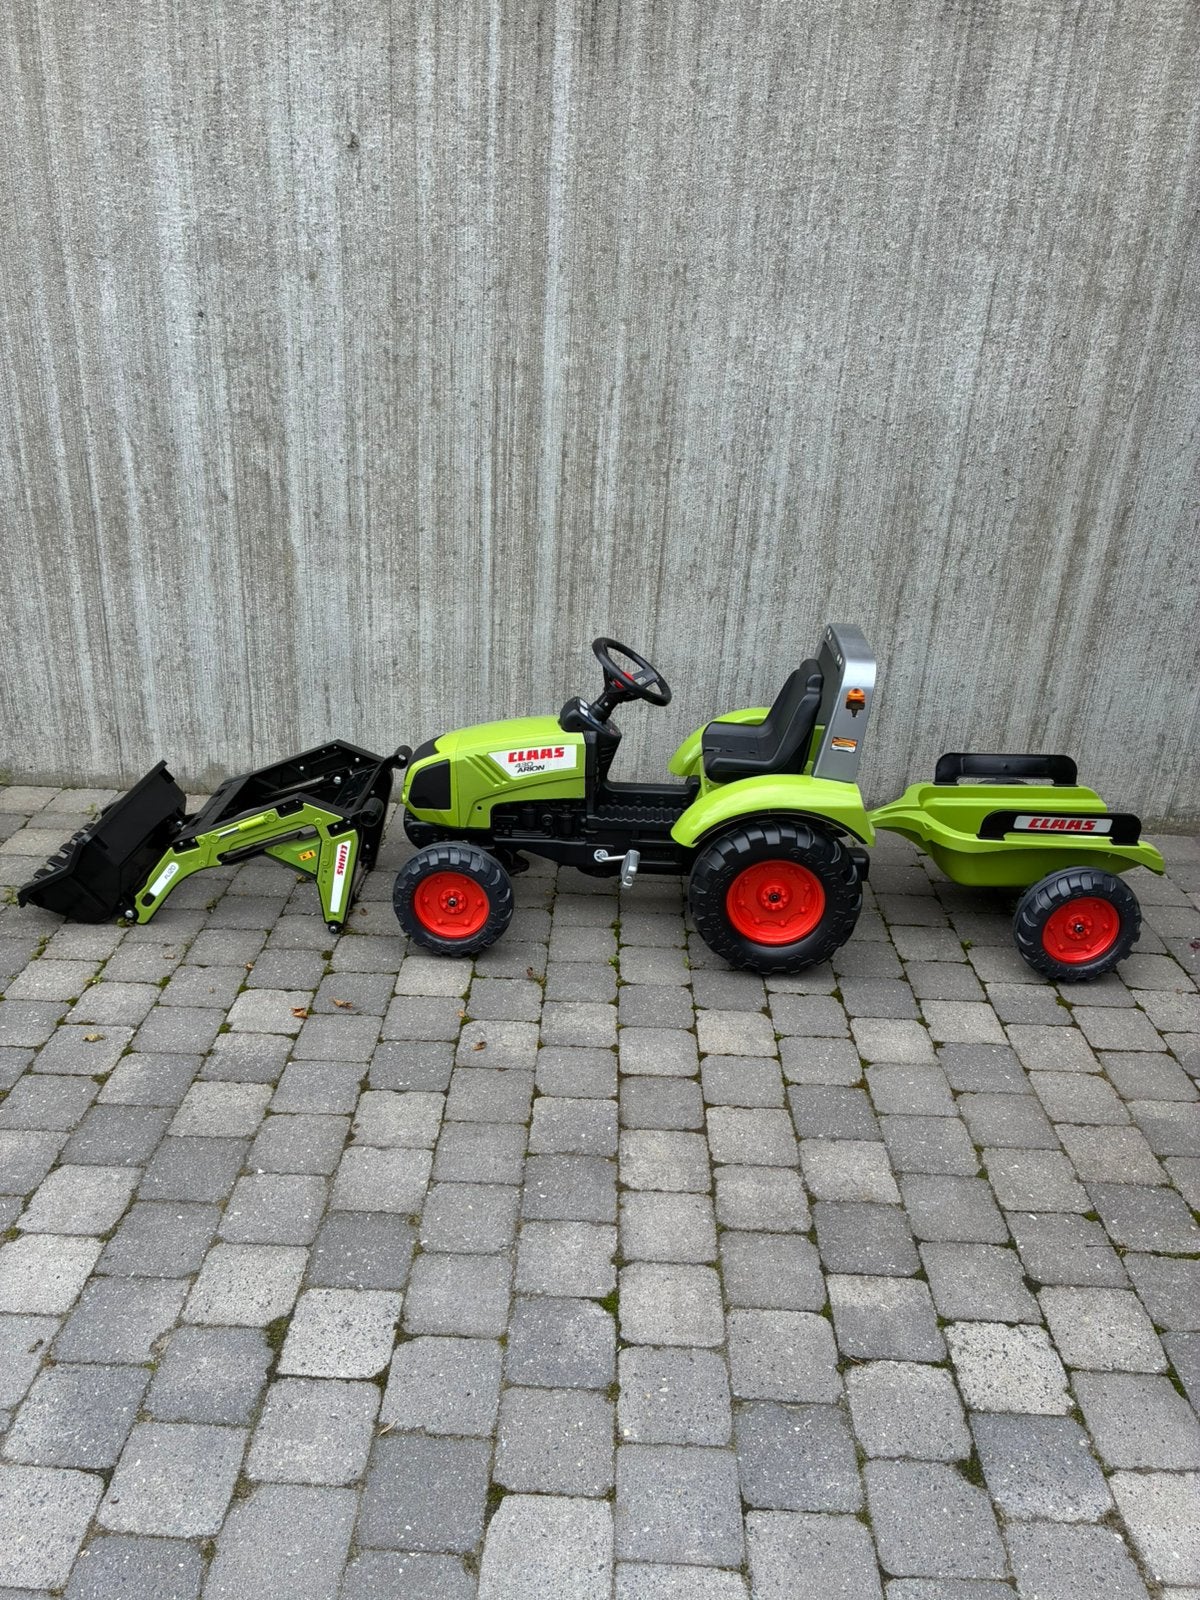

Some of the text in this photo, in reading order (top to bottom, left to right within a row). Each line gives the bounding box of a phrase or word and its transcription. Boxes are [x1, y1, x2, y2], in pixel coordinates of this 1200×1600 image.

[508, 747, 565, 763] CLAAS
[517, 765, 546, 773] ARION
[1028, 818, 1098, 831] CLAAS
[336, 844, 348, 876] CLAAS
